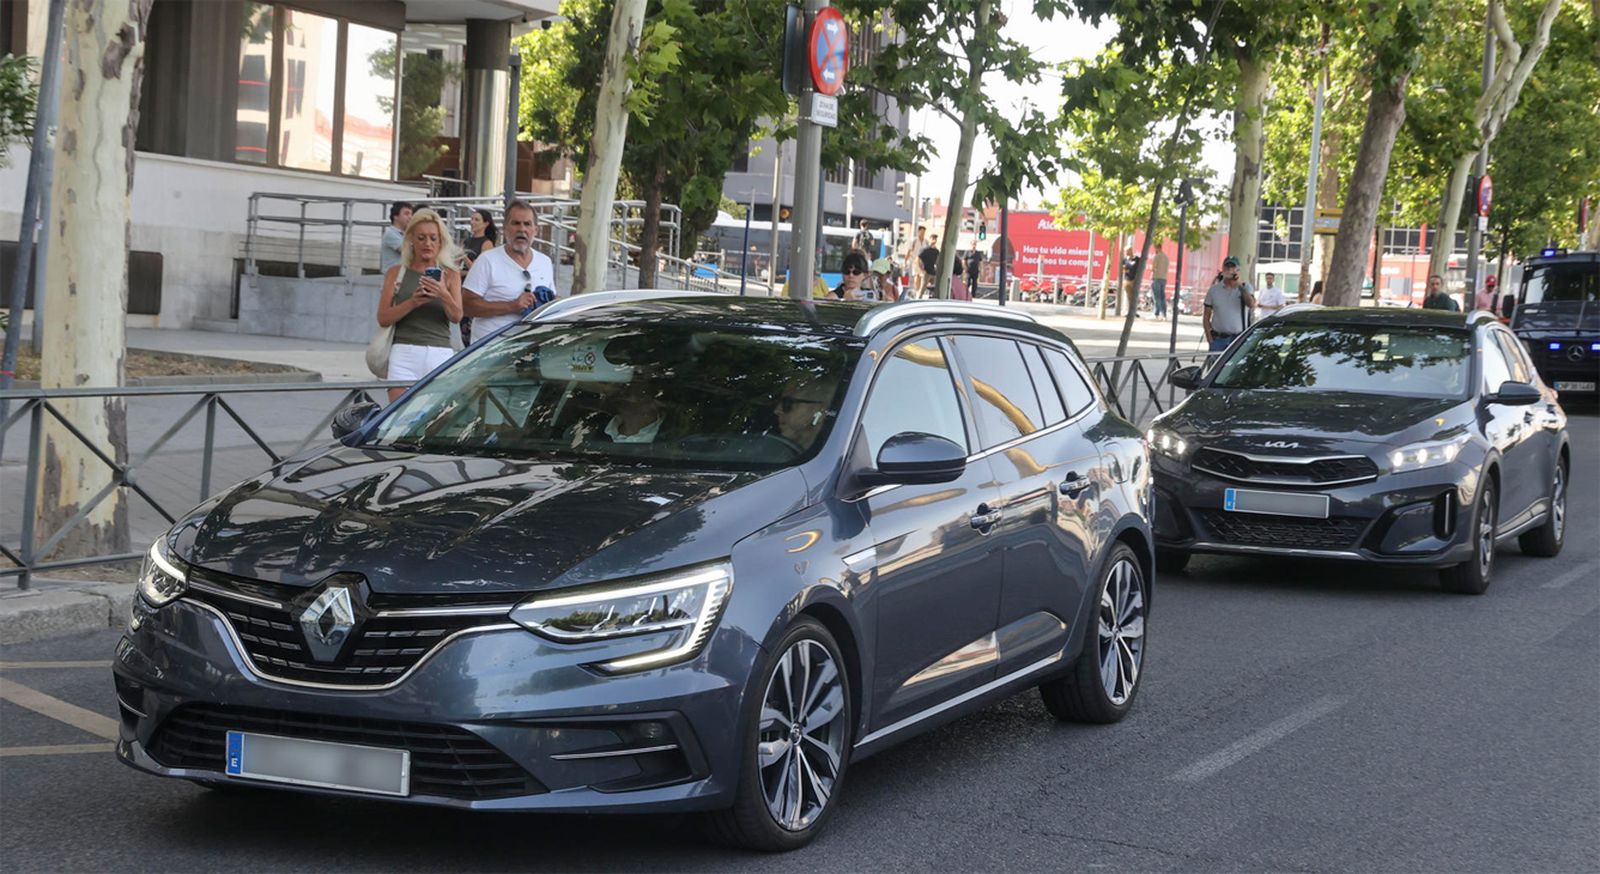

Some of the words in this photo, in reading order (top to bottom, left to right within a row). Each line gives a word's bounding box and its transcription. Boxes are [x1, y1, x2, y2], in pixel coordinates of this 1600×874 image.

[1023, 245, 1038, 254] Haz
[1040, 246, 1048, 254] tu
[1050, 246, 1067, 255] vida
[1068, 247, 1104, 256] mienas
[1068, 260, 1101, 268] compa.
[231, 758, 238, 767] E
